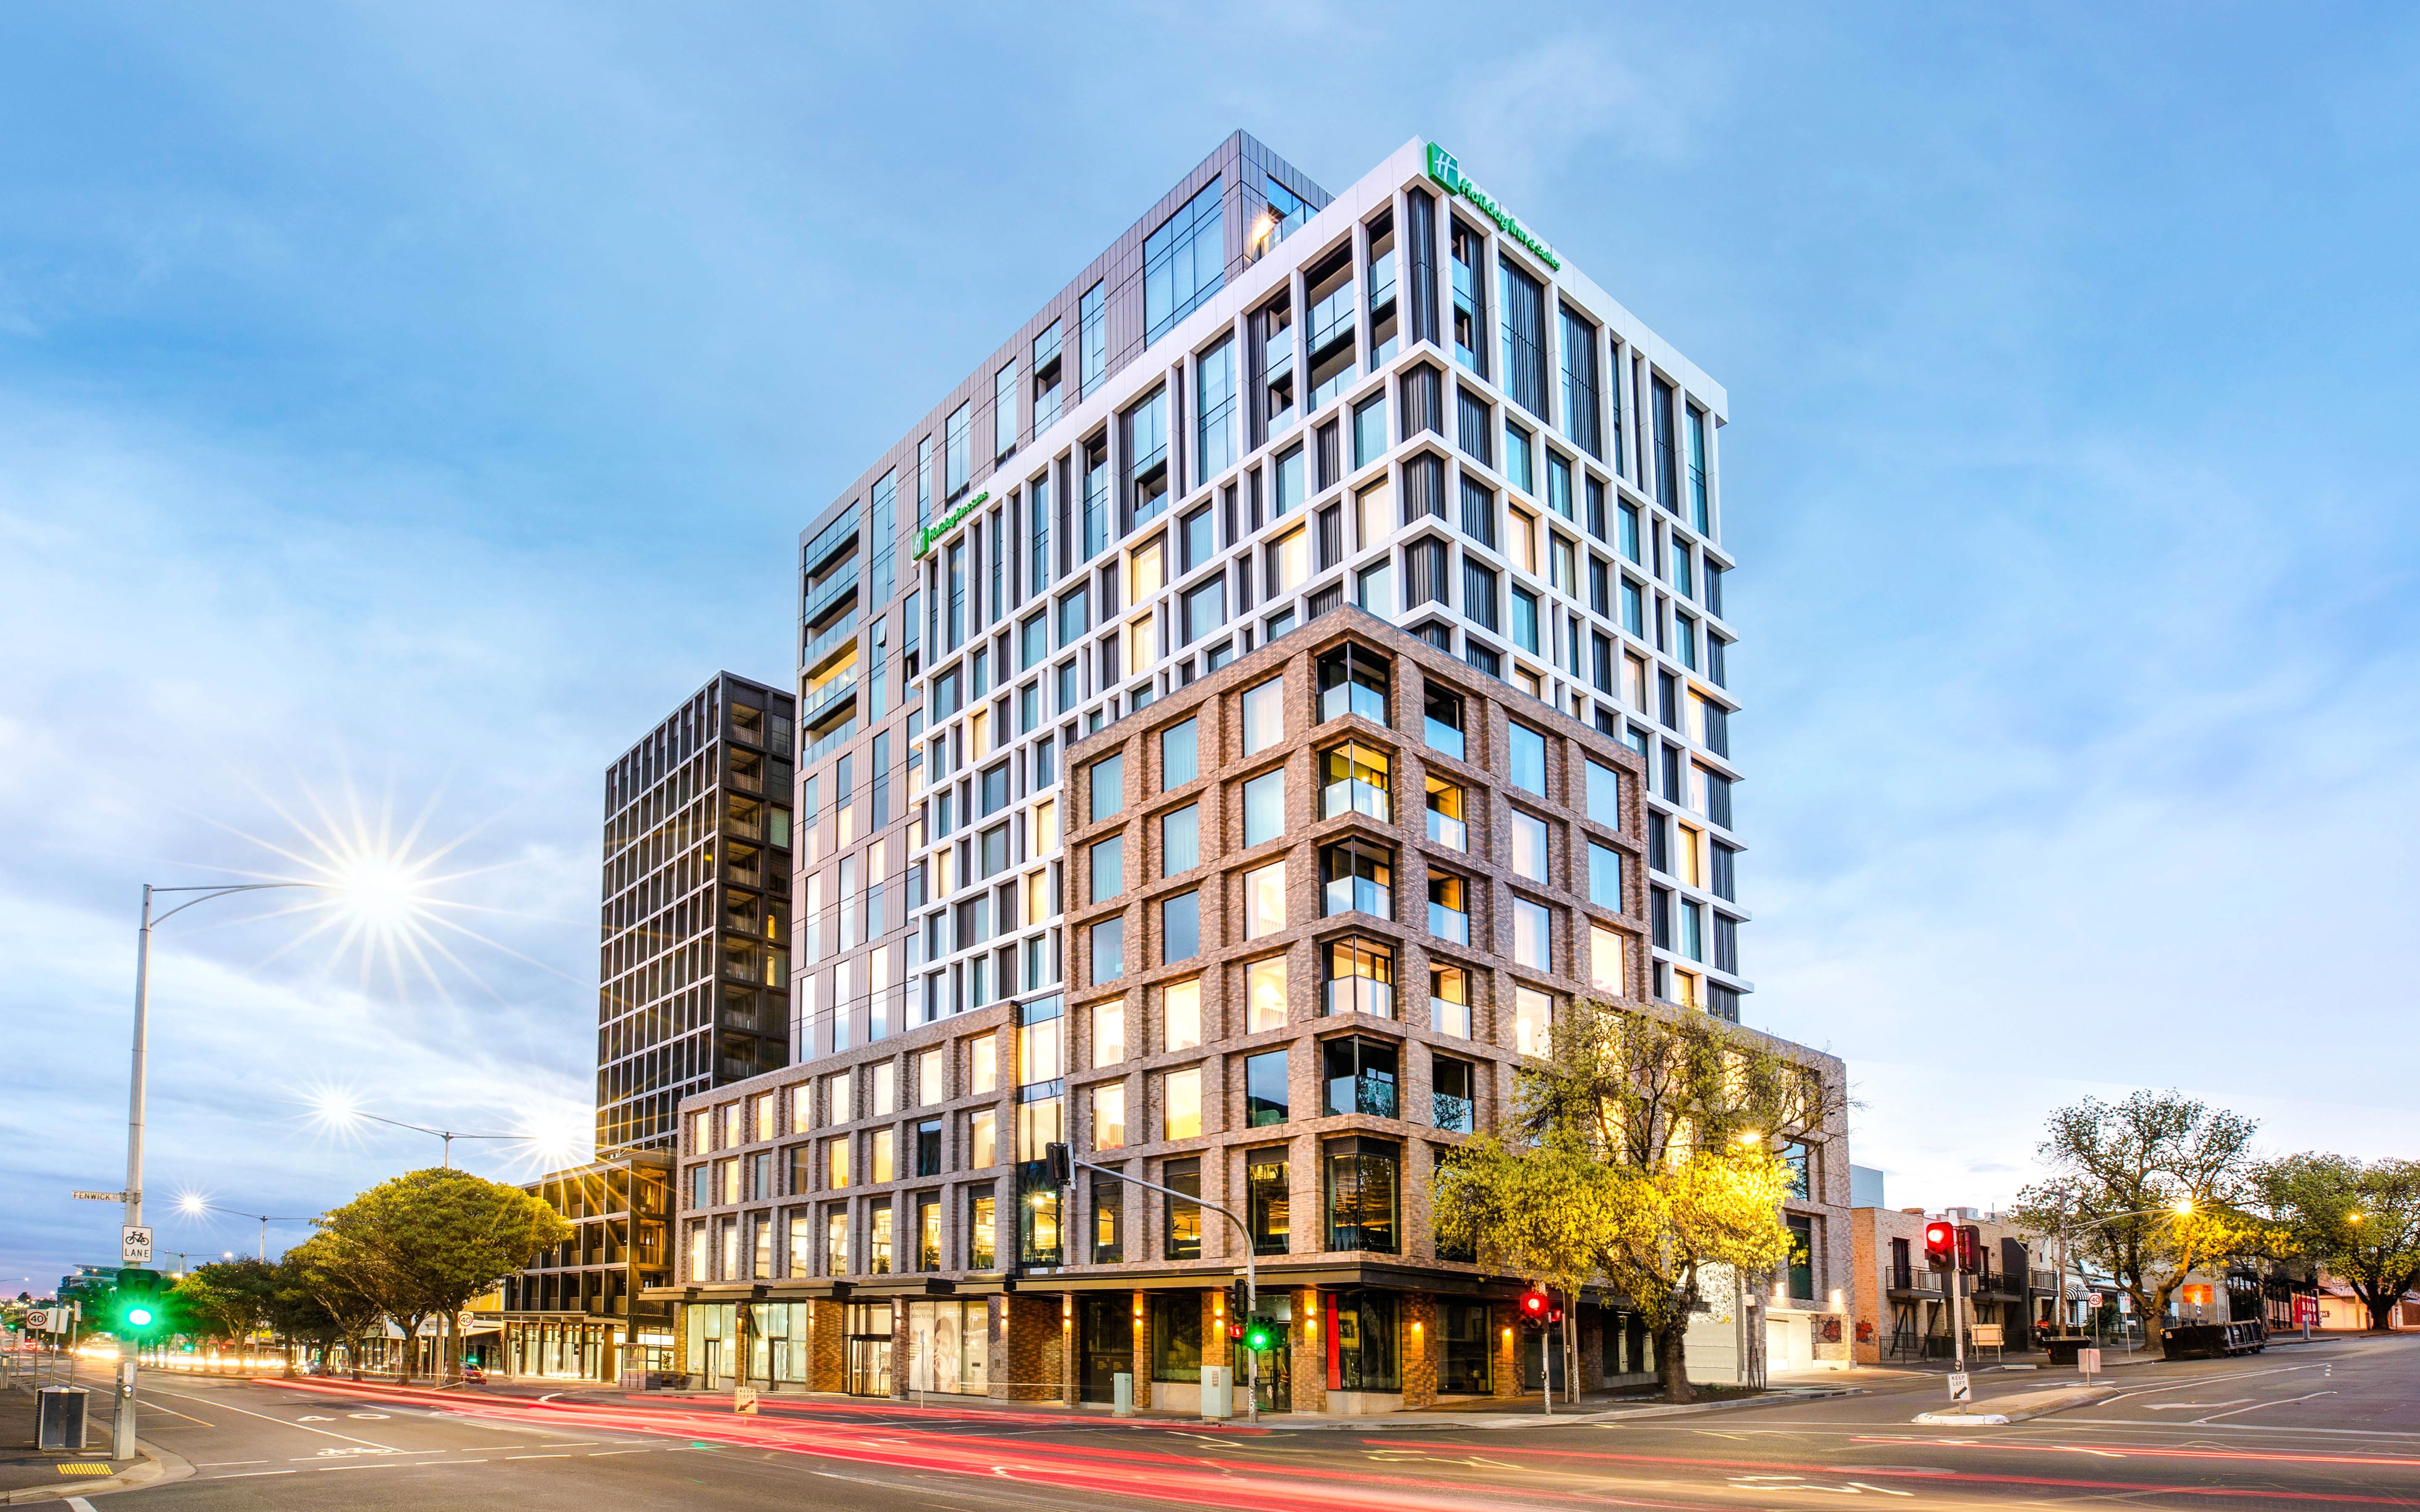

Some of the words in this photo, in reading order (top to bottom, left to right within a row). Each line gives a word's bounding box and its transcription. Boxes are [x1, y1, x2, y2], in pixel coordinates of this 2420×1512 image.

[1459, 178, 1510, 232] Holiday
[1508, 218, 1528, 246] Inn
[1534, 244, 1560, 272] Suites
[930, 514, 957, 542] Holiday
[74, 1192, 110, 1200] FENWICK
[125, 1248, 149, 1257] LANE
